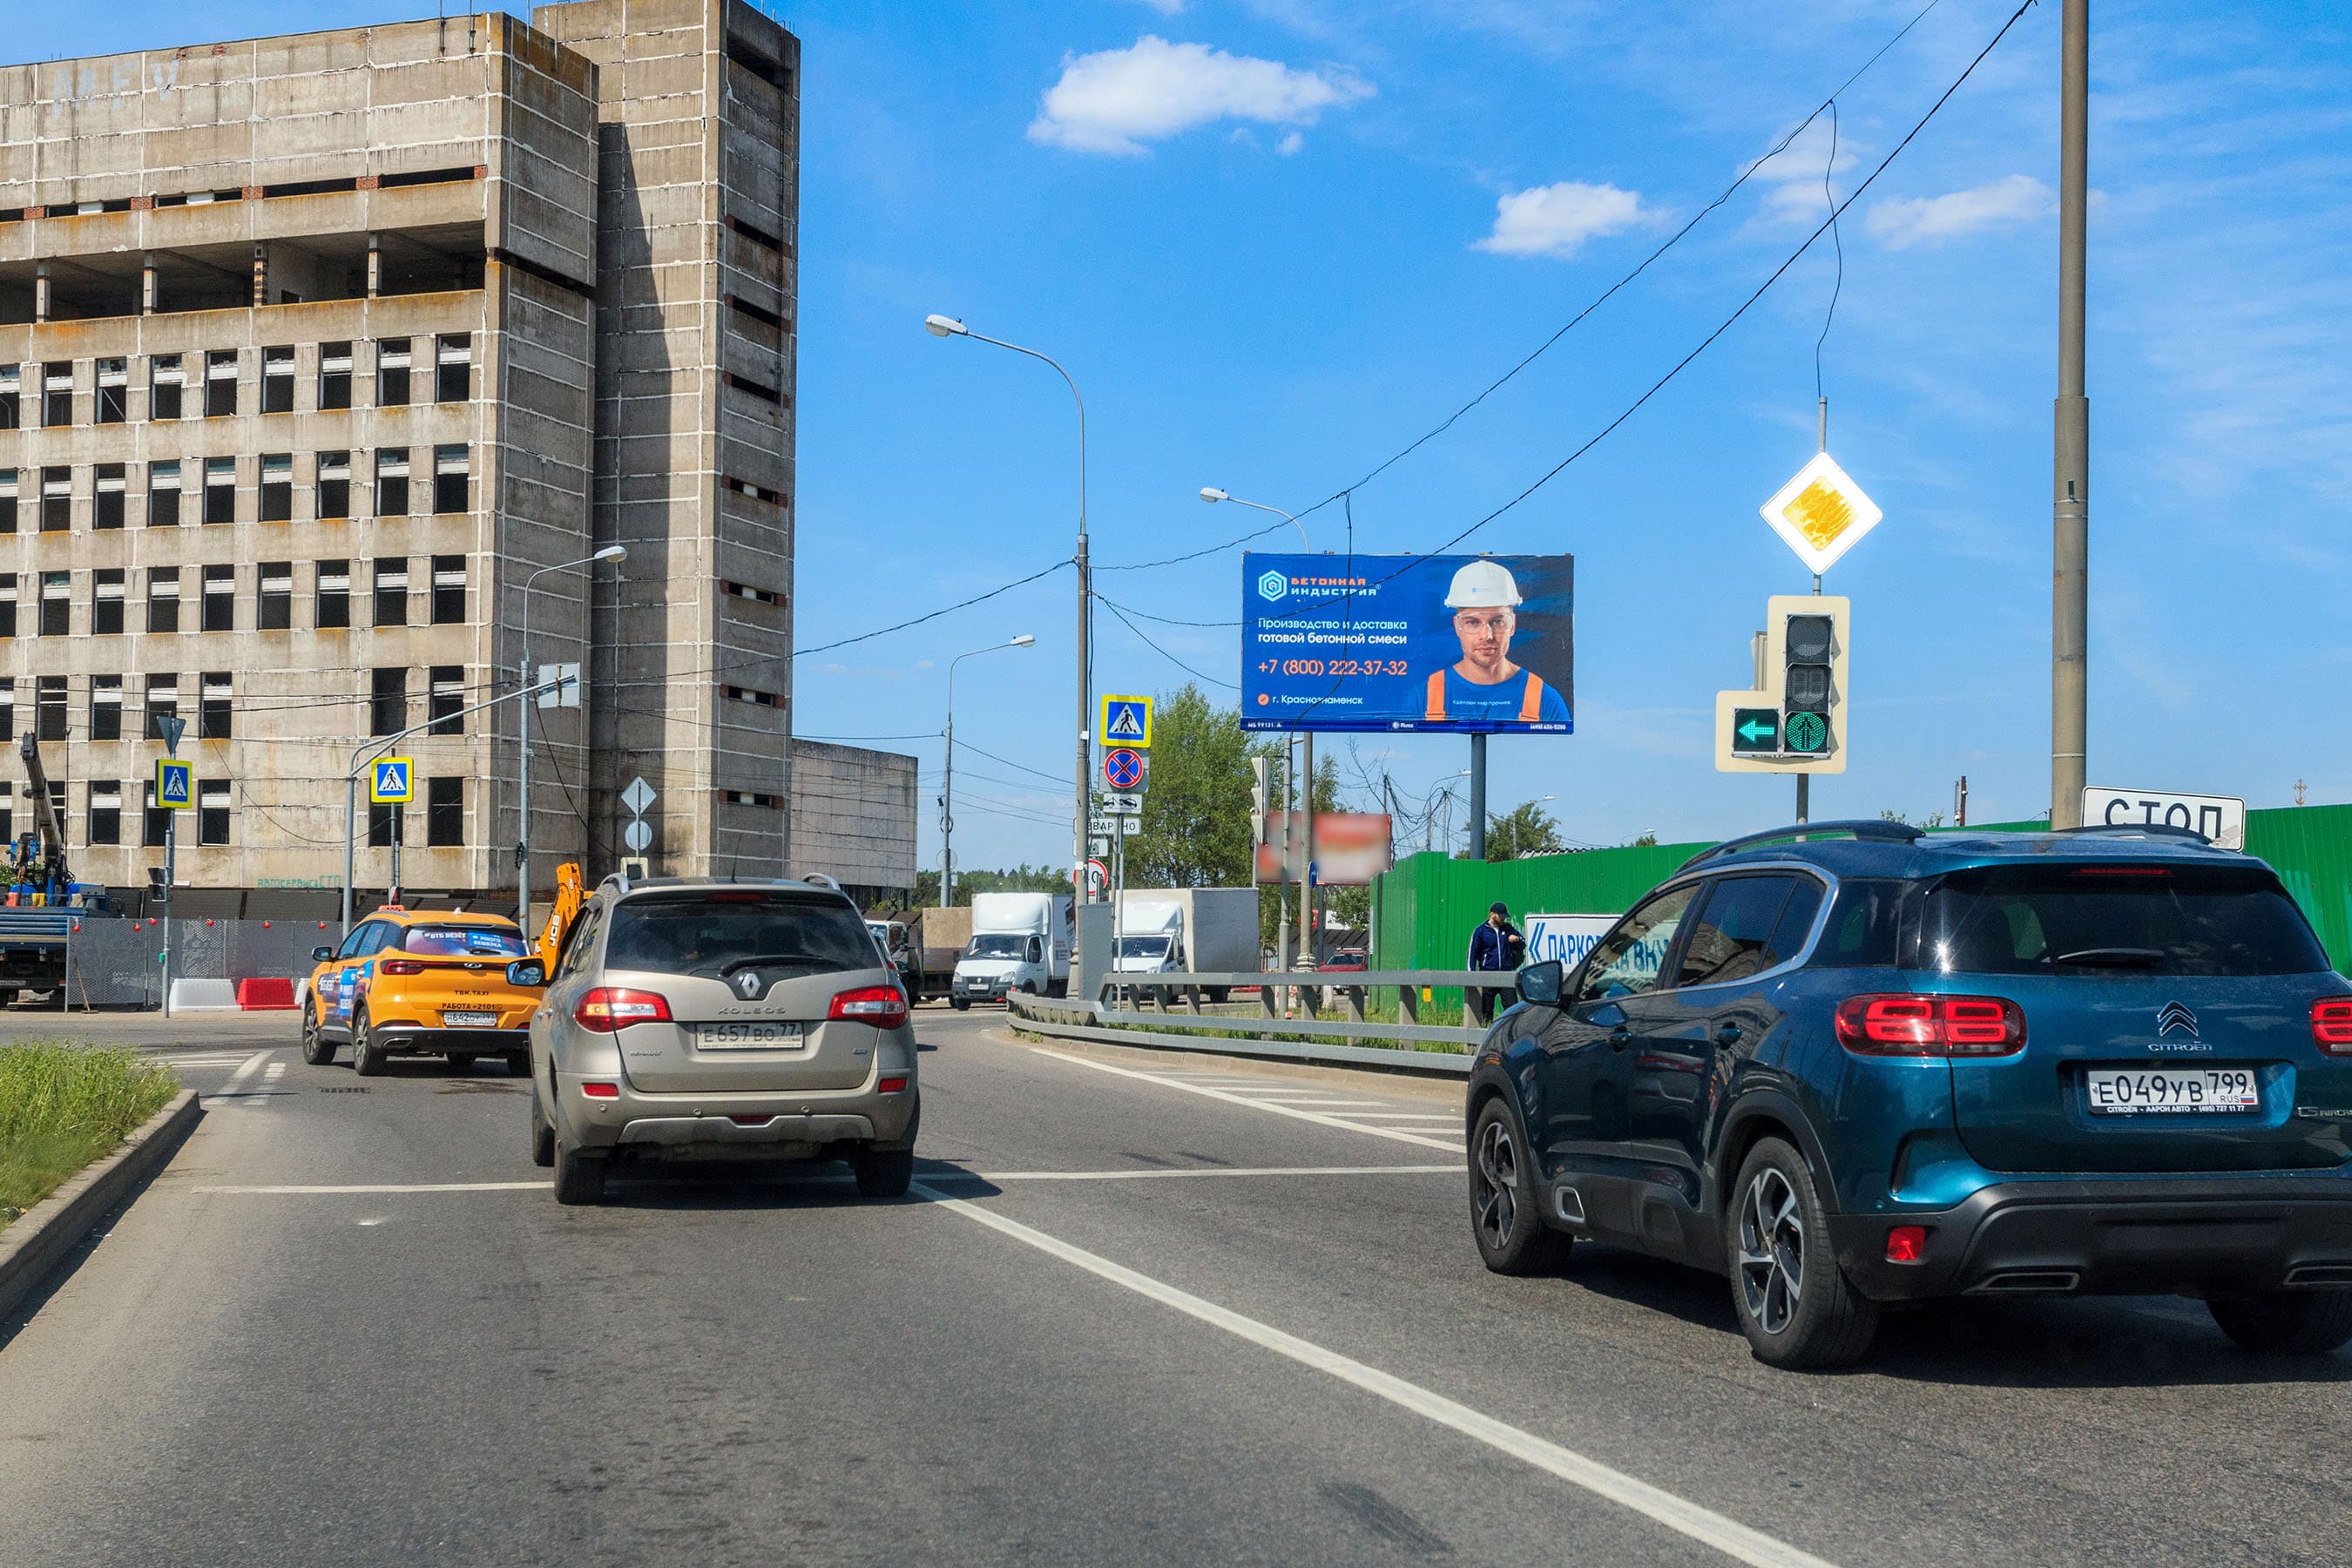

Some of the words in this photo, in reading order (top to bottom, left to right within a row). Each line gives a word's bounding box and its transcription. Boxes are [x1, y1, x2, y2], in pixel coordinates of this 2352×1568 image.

[1291, 588, 1376, 597] ИНДУСТРИЯ
[1258, 618, 1340, 630] Производство
[1353, 621, 1408, 630] доставка
[1258, 632, 1305, 643] готовой
[1308, 632, 1366, 644] бетонной
[1369, 635, 1408, 644] смеси
[1258, 659, 1278, 674] +7
[1282, 659, 1324, 676] (800)
[1328, 660, 1408, 675] 222-37-32
[1281, 695, 1363, 705] Краснознаменск
[2105, 798, 2222, 839] СТОП
[549, 914, 560, 947] JCB
[2220, 1095, 2240, 1104] RUS
